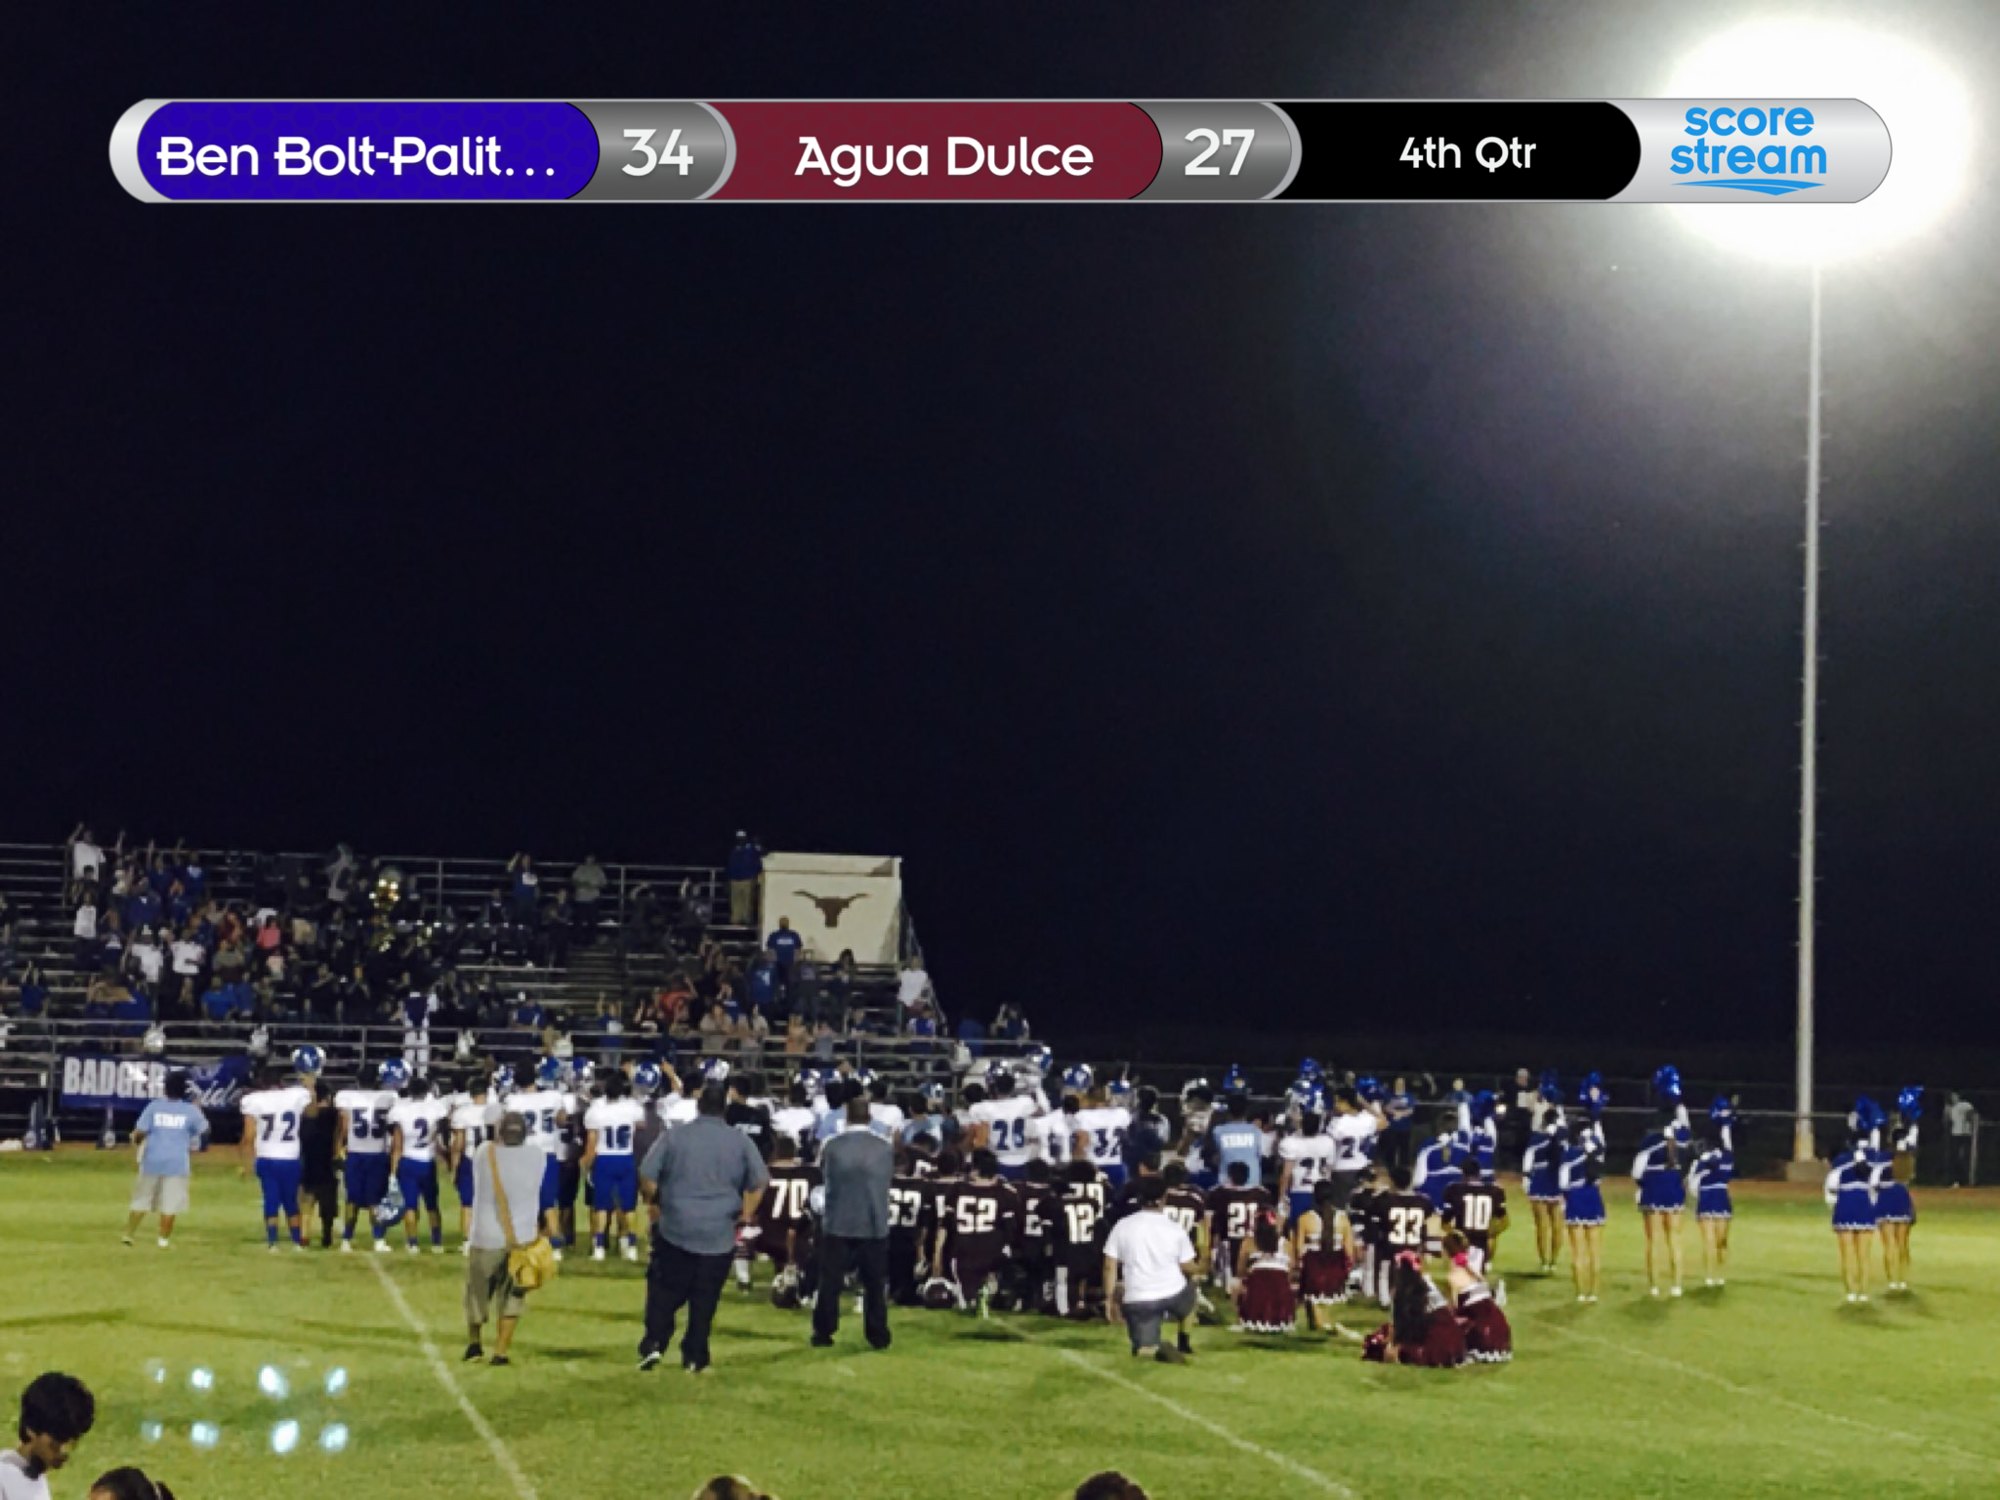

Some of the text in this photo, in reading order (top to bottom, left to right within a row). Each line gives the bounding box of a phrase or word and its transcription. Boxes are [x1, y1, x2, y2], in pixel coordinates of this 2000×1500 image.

[63, 1056, 186, 1099] BADGER
[261, 1111, 296, 1141] 72
[352, 1107, 387, 1139] 55
[769, 1179, 809, 1219] 70
[957, 1195, 997, 1233] 52
[1463, 1194, 1492, 1231] 10
[1064, 1204, 1094, 1243] 12
[1388, 1206, 1424, 1245] 33
